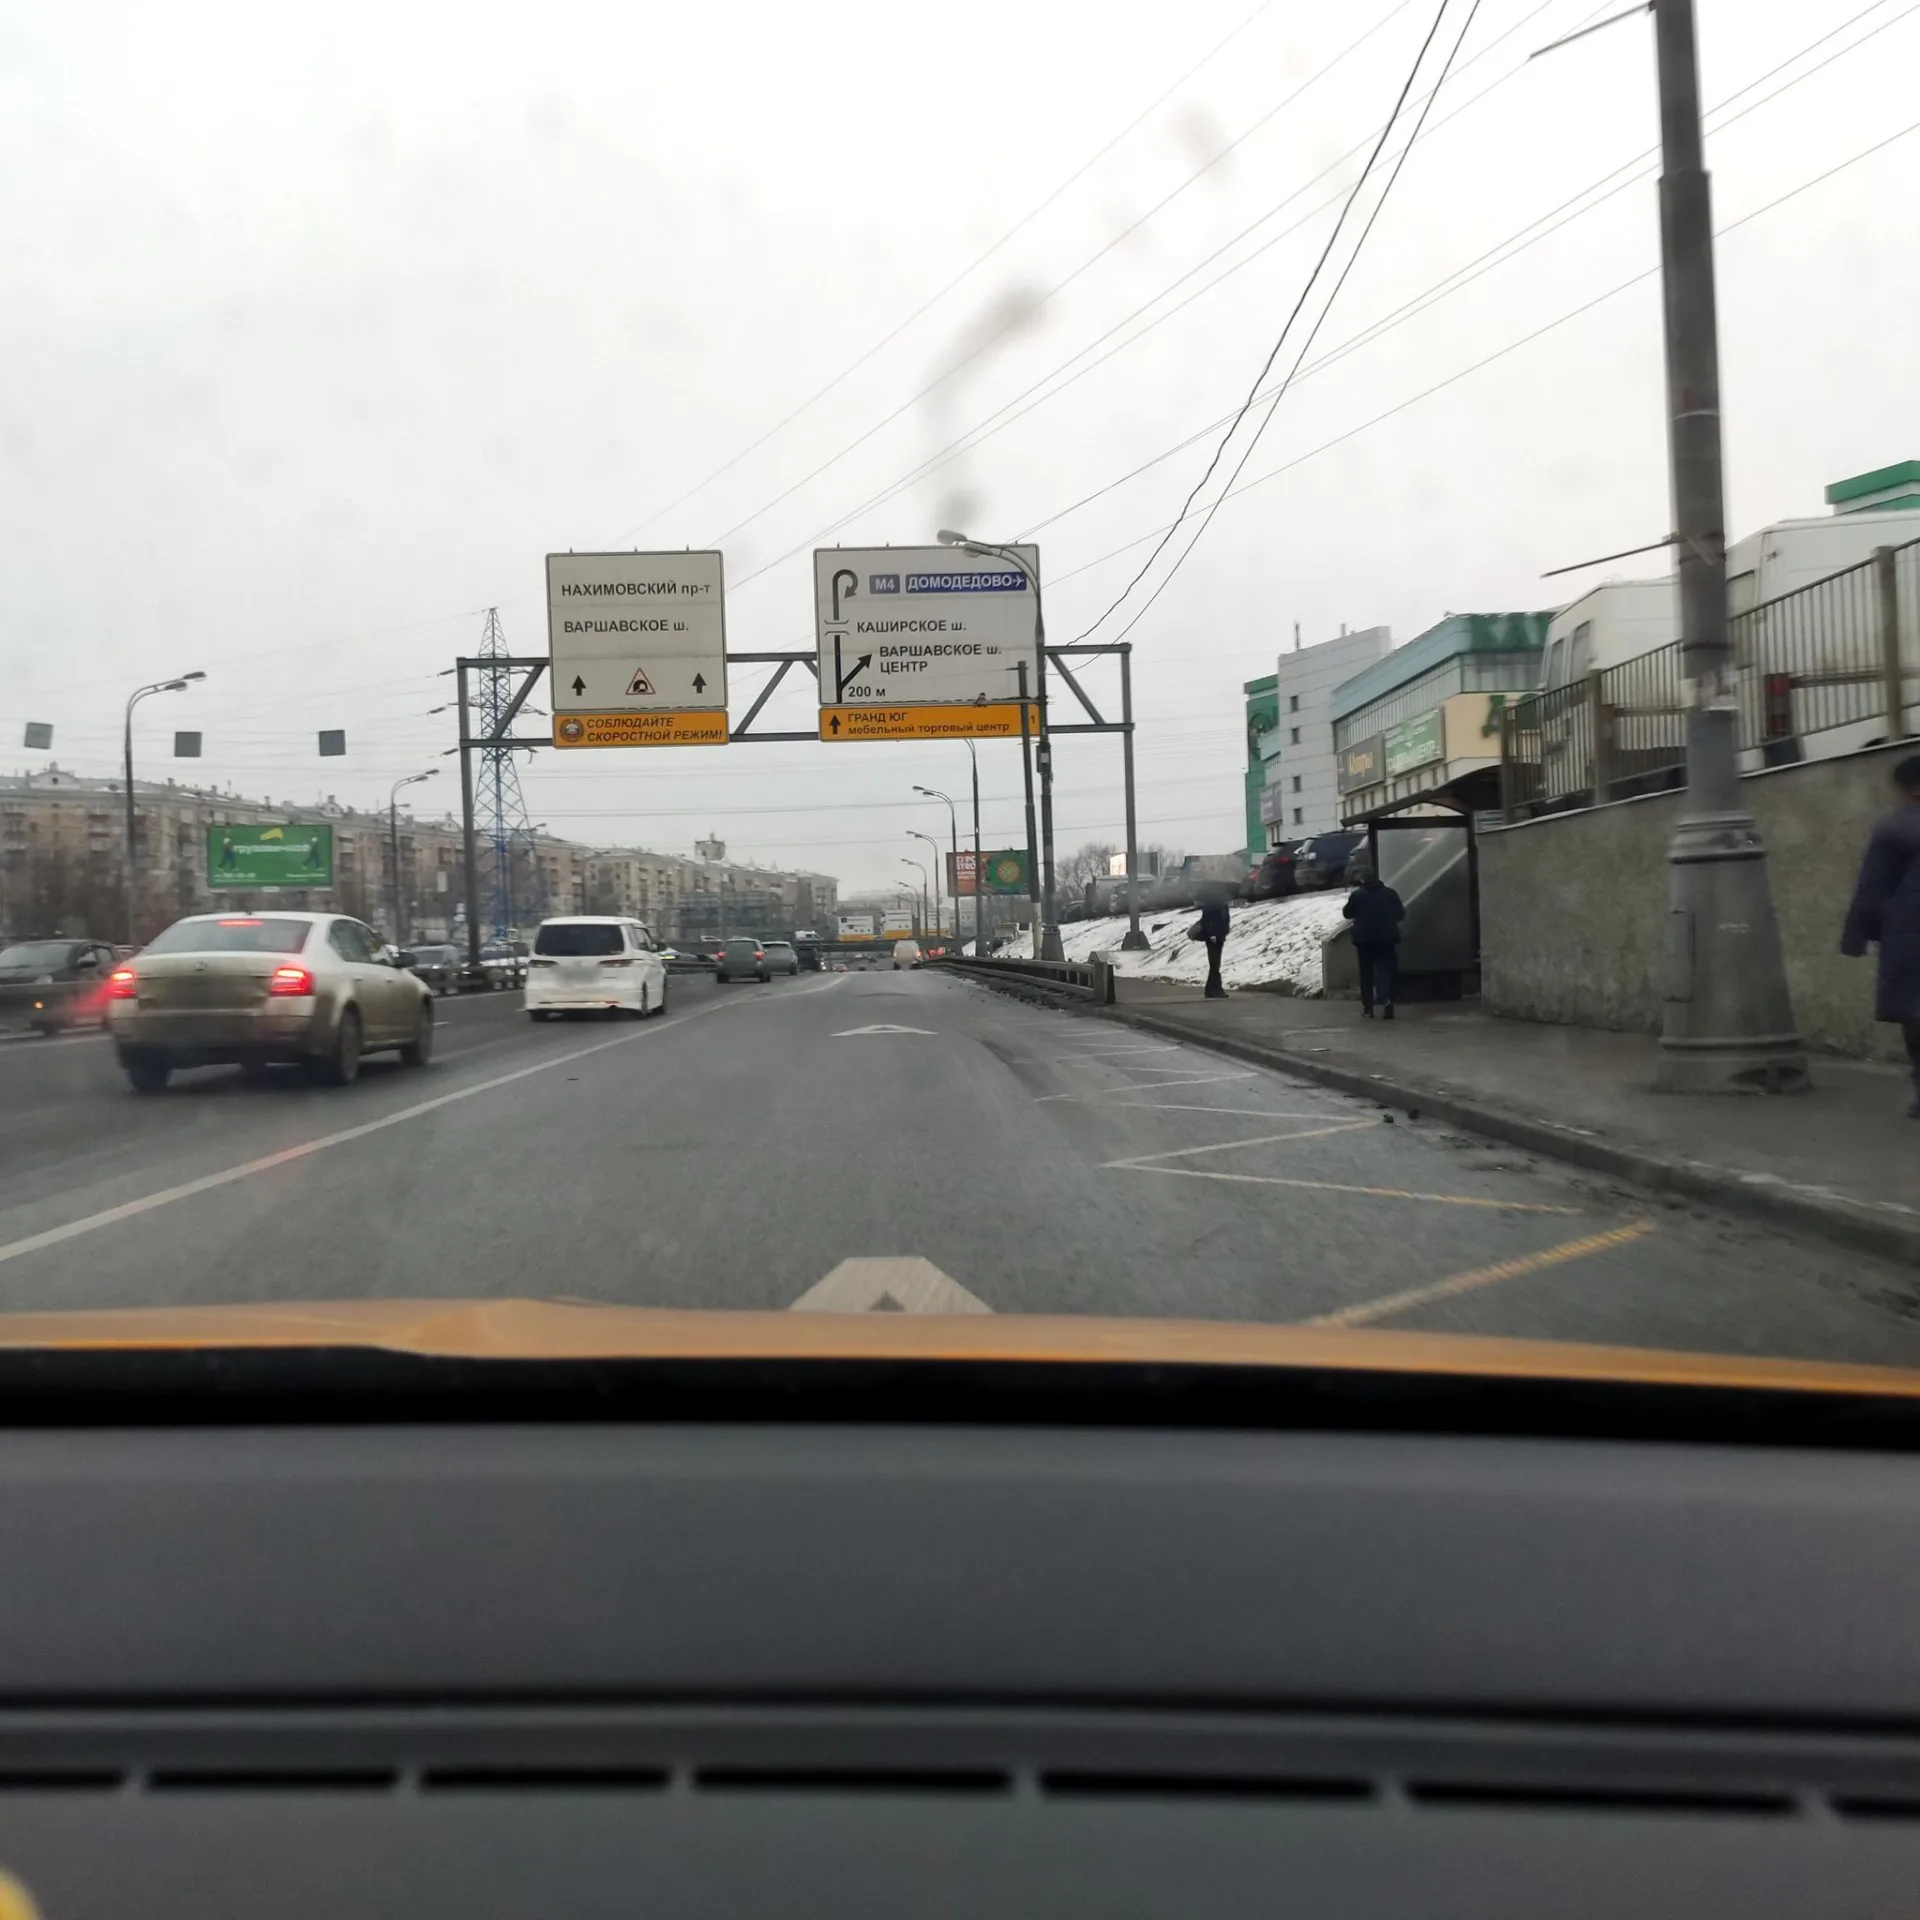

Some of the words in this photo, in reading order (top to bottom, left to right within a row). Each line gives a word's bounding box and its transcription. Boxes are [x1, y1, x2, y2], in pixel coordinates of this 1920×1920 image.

[561, 580, 677, 596] НАХИМОВСКИЙ
[681, 584, 711, 597] пр-т
[907, 574, 1012, 590] ДОМОДЕДОВО
[564, 620, 669, 633] ВАРШАВСКОЕ
[673, 622, 689, 631] ш.
[857, 620, 947, 633] КАШИРСКОЕ
[951, 622, 967, 631] ш.
[879, 644, 982, 657] ВАРШАВСКОЕ
[986, 646, 1002, 655] ш.
[880, 661, 928, 675] ЦЕНТР
[848, 686, 872, 698] 200
[876, 688, 886, 697] м
[587, 717, 674, 729] СОБЛЮДАЙТЕ
[848, 713, 886, 723] ГРАНД
[889, 712, 908, 721] ЮГ
[848, 723, 914, 735] мебельный
[918, 722, 972, 734] торговый
[976, 722, 1010, 734] центр
[587, 730, 671, 742] СКОРОСТНОЙ
[674, 730, 722, 740] РЕЖИМ!
